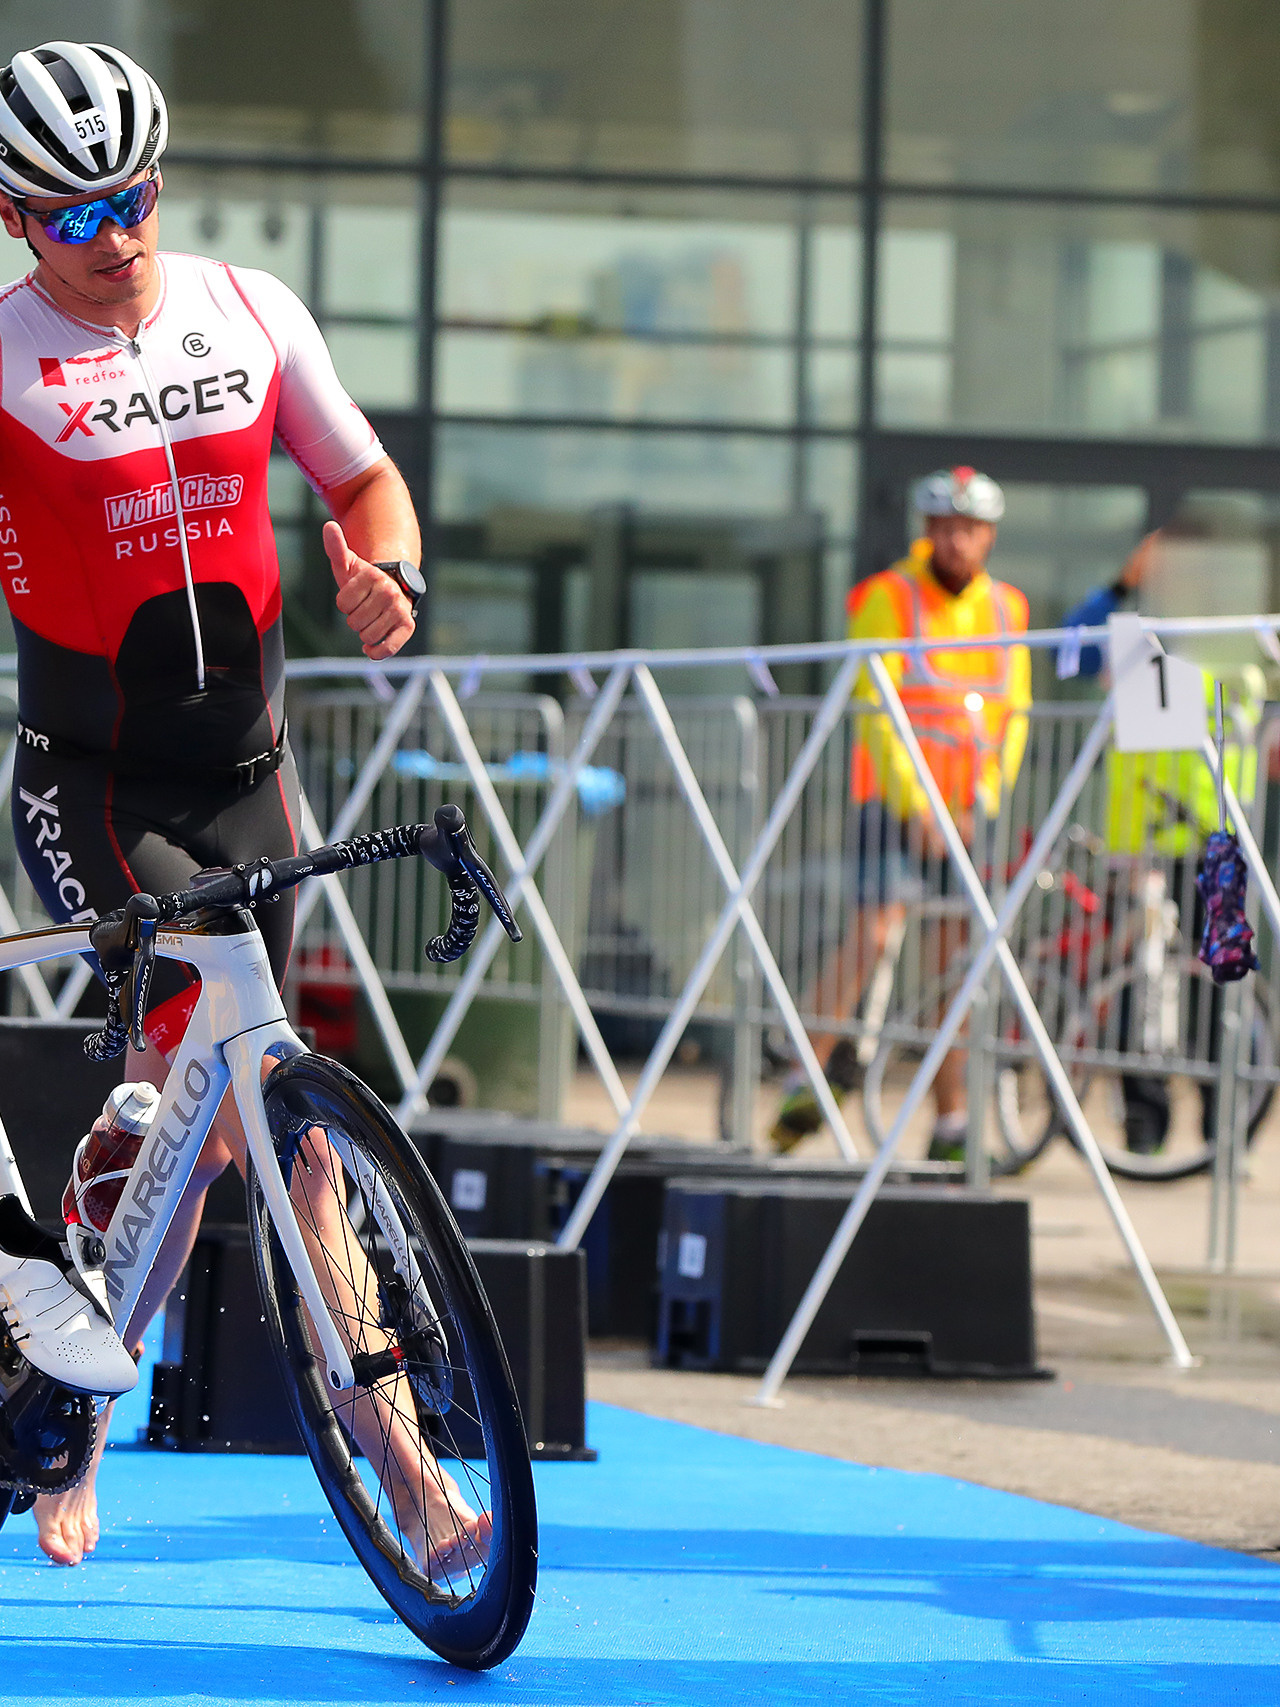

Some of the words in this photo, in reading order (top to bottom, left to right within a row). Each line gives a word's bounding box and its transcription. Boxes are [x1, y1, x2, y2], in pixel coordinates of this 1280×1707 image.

[74, 114, 106, 140] 515
[75, 369, 126, 387] redfox
[55, 368, 254, 444] XRACER
[110, 483, 173, 527] World
[182, 474, 241, 508] Class
[115, 517, 234, 560] RUSSIA
[1151, 655, 1169, 709] 1
[25, 728, 50, 752] TYR
[19, 785, 99, 923] XRACE
[105, 1058, 211, 1301] INARELLO
